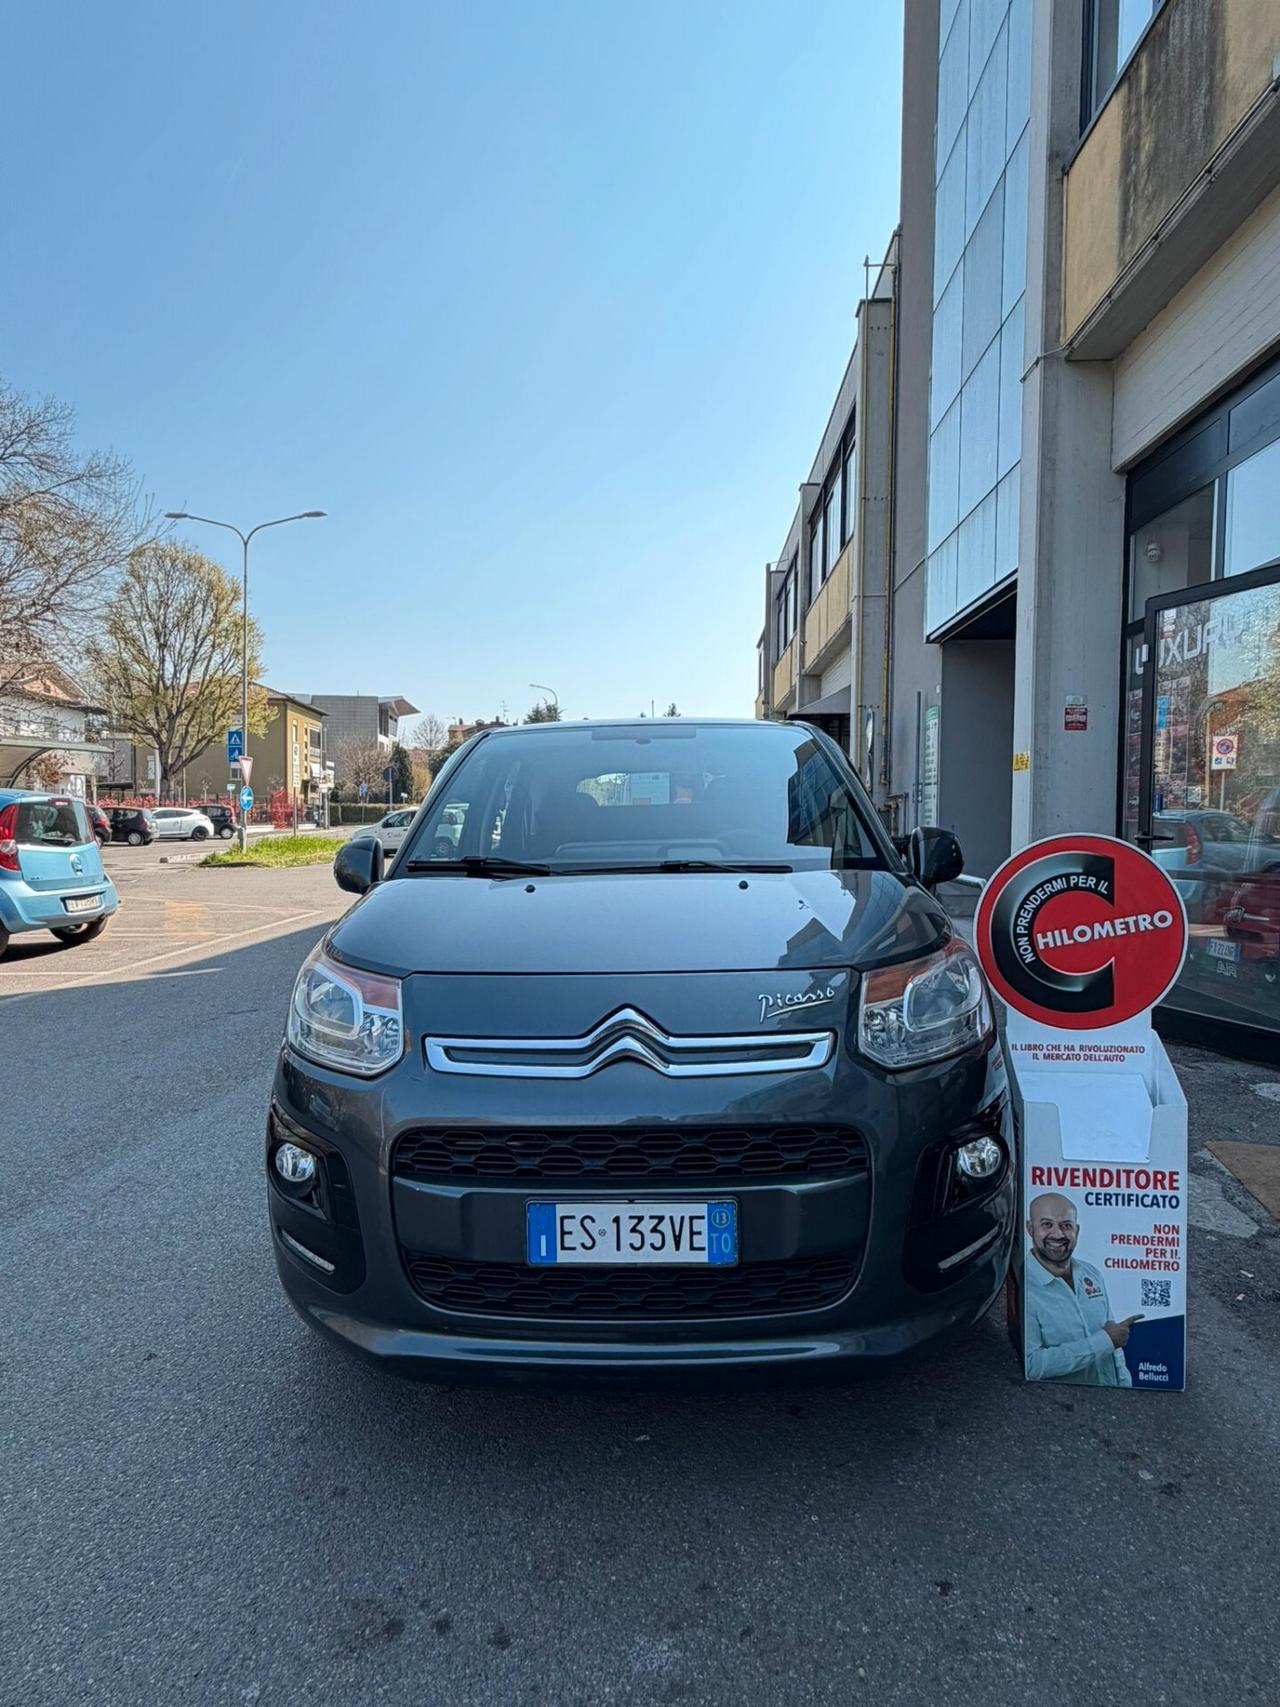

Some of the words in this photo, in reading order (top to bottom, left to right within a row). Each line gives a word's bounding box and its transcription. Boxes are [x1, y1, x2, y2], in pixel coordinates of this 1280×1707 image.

[1070, 875, 1096, 889] PER
[1097, 880, 1109, 894] IL
[1016, 878, 1068, 934] PRENDERMI
[1036, 910, 1174, 950] HILOMETRO
[1016, 937, 1036, 964] NON
[1011, 1043, 1019, 1051] IL
[1020, 1043, 1044, 1052] LIBRO
[1046, 1043, 1062, 1052] CHE
[1063, 1044, 1075, 1052] HA
[1079, 1044, 1145, 1054] RIVOLUZIONATO
[1043, 1053, 1081, 1061] MERCATO
[1083, 1054, 1126, 1063] DELL'AUTO
[1031, 1166, 1180, 1191] RIVENDITORE
[1084, 1191, 1180, 1209] CERTIFICATO
[714, 1210, 729, 1224] 13
[559, 1214, 597, 1252] ES
[611, 1214, 706, 1252] 133VE
[710, 1232, 731, 1254] TO
[1153, 1223, 1180, 1235] NON
[1111, 1234, 1180, 1247] PRENDERMI
[1145, 1247, 1167, 1259] PER
[1104, 1258, 1180, 1271] CHILOMETRO
[1138, 1361, 1168, 1372] Alfredo
[1138, 1371, 1169, 1381] Bellucci
